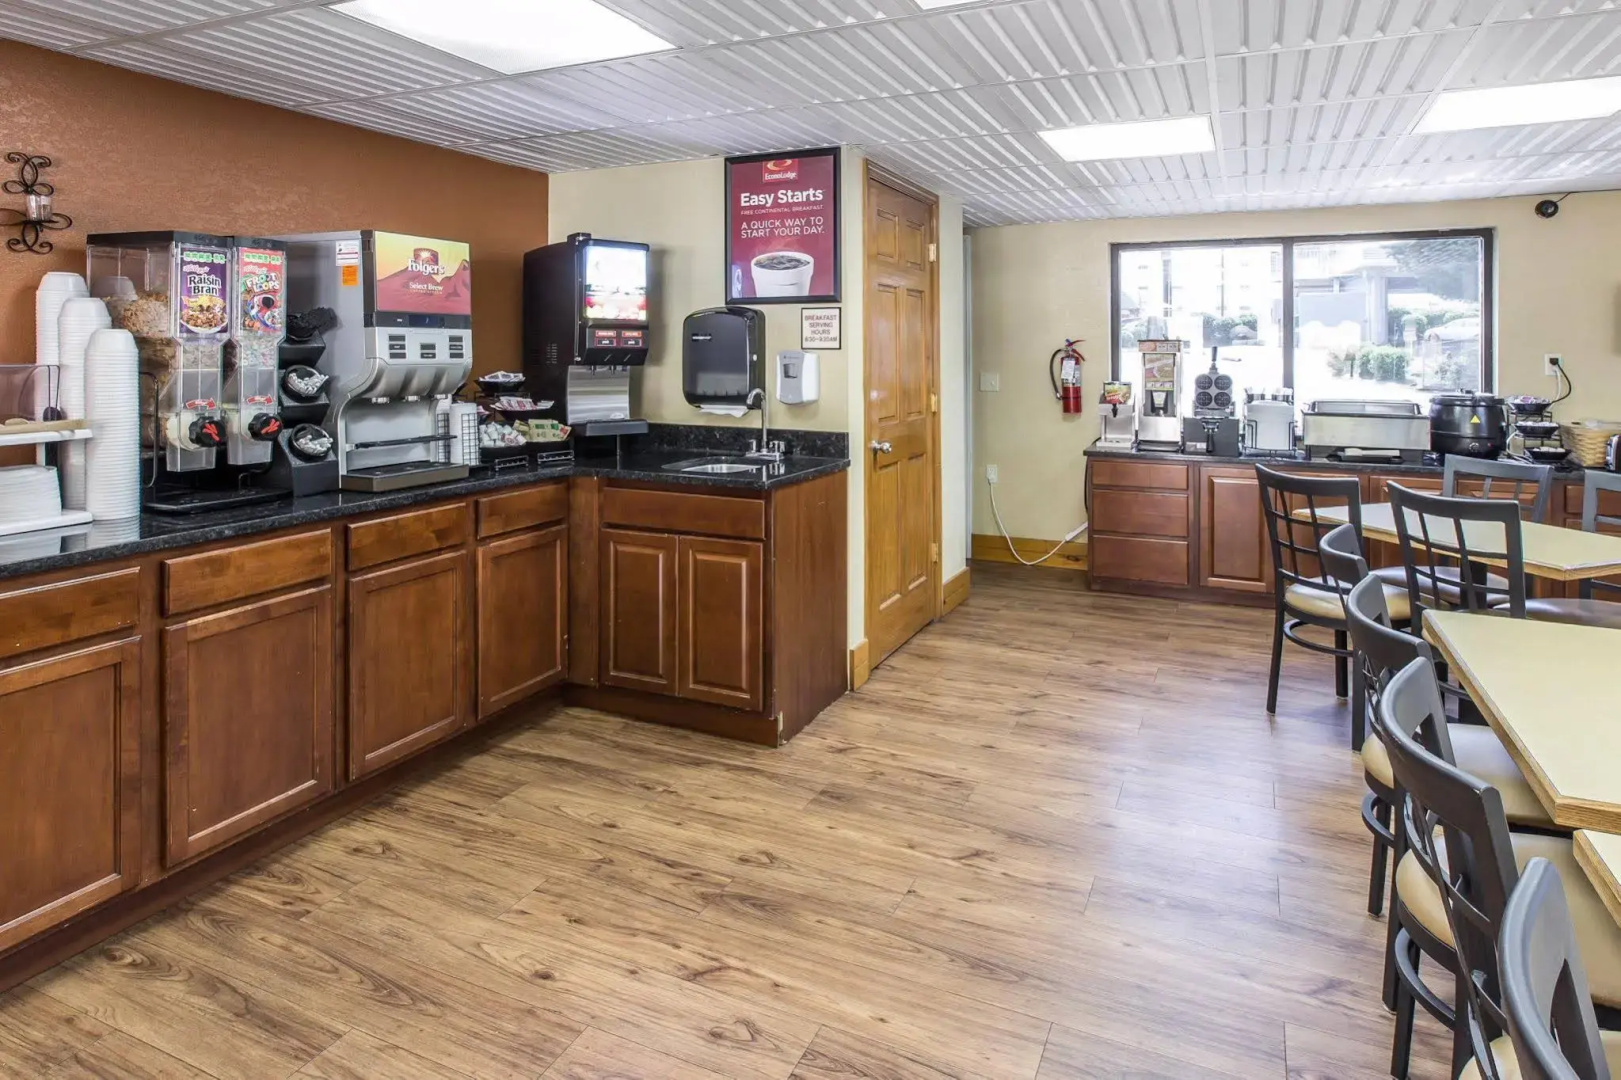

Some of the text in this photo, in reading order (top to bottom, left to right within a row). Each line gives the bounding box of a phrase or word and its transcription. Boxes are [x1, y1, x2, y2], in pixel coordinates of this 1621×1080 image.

[740, 188, 823, 207] Easy Starts
[754, 207, 790, 215] CONTINENTAL
[741, 216, 824, 230] A QUICK WAY TO
[741, 225, 825, 239] START YOUR DAY.
[408, 259, 445, 275] Folgers
[188, 274, 221, 287] Raisin
[253, 281, 279, 292] LOOPS
[410, 282, 443, 291] Select Brew
[192, 285, 219, 296] Bran
